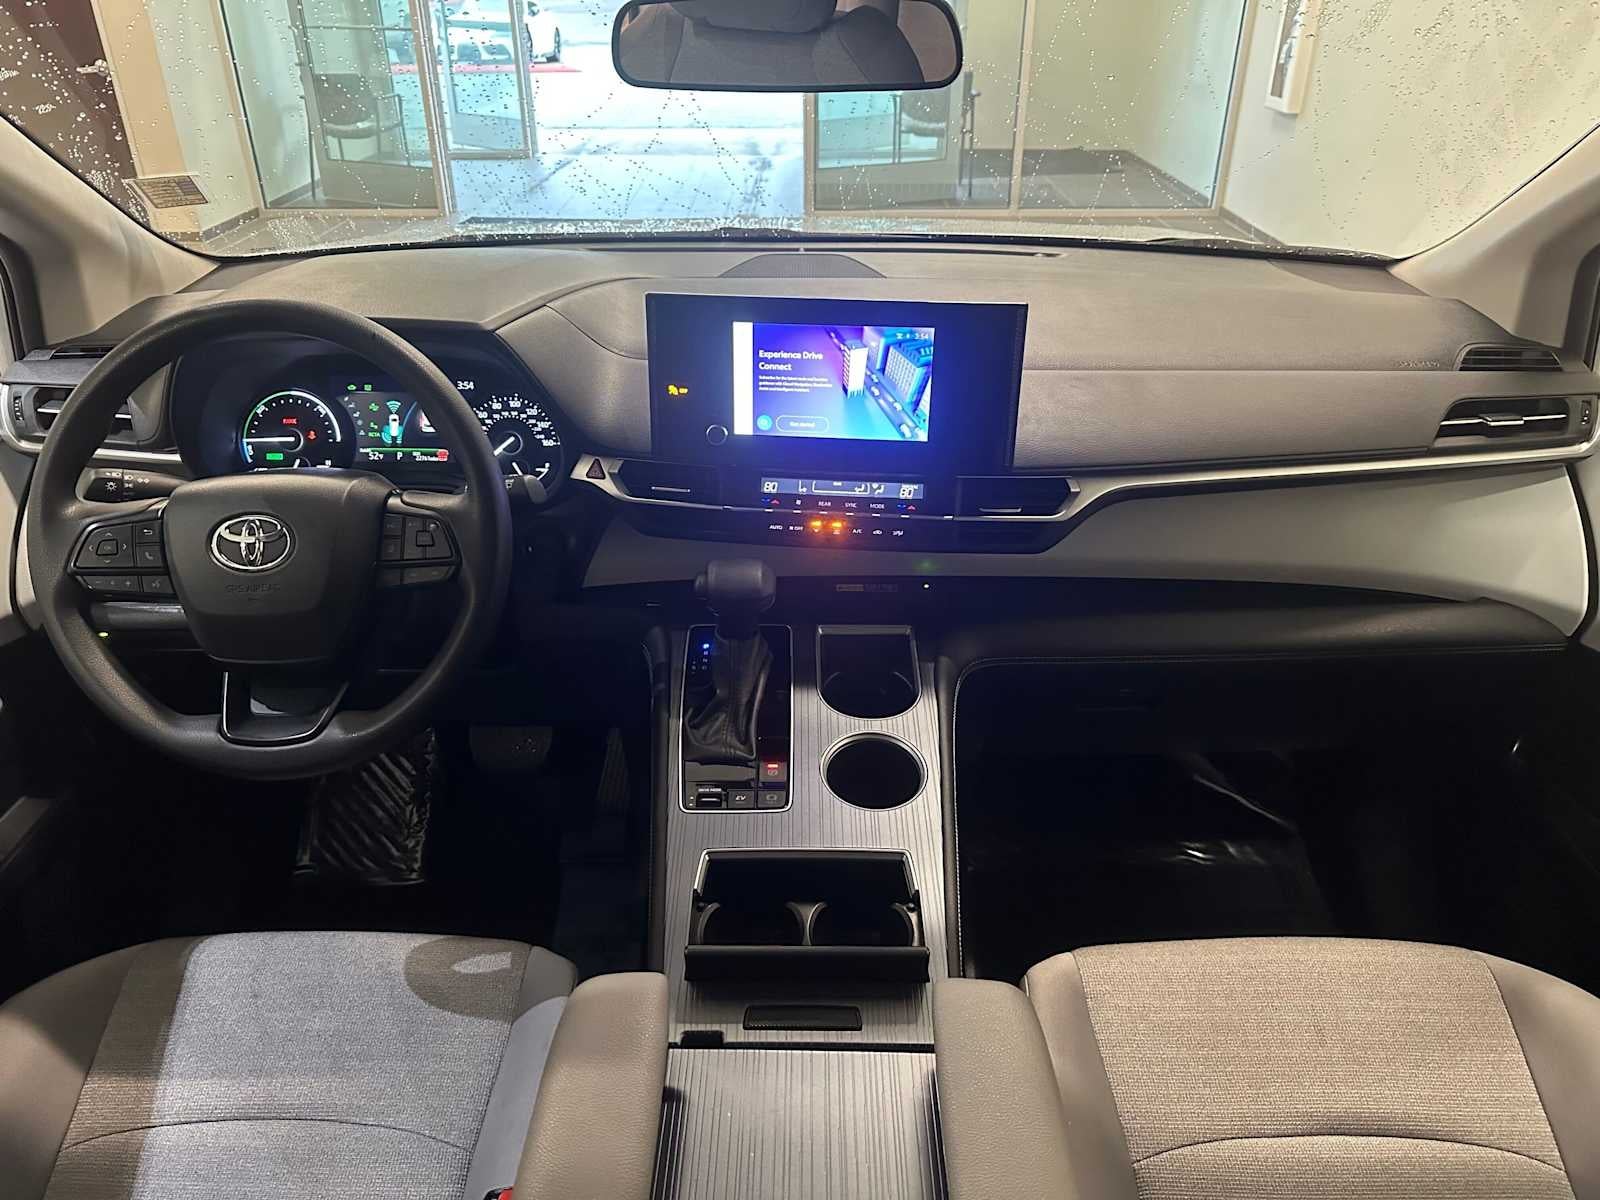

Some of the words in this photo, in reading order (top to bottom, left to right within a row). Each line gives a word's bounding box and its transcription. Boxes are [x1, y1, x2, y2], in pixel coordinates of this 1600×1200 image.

[758, 350, 801, 361] Experience
[802, 351, 824, 361] Drive
[758, 361, 792, 372] Connect
[457, 381, 474, 390] 3:54
[508, 400, 521, 408] 100
[477, 411, 488, 419] 60
[525, 408, 538, 416] 120
[541, 439, 554, 447] 160
[763, 482, 778, 493] 80
[899, 487, 914, 499] 80
